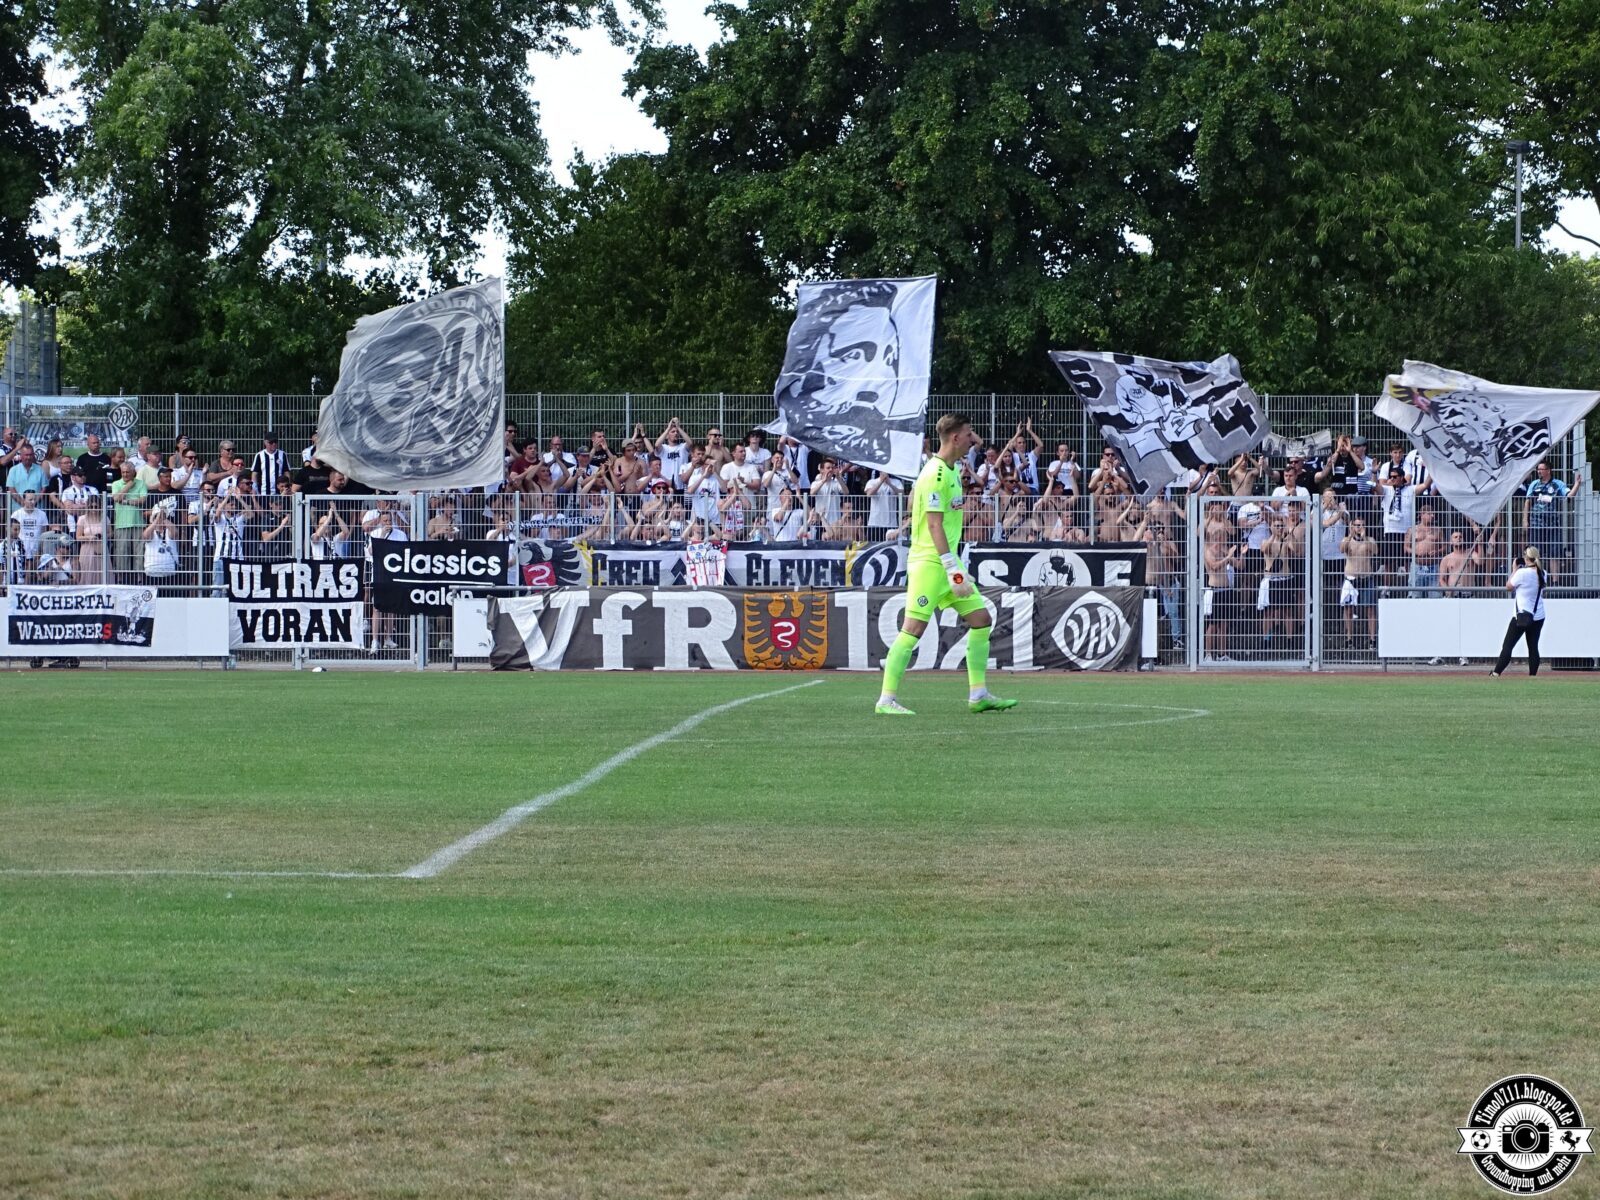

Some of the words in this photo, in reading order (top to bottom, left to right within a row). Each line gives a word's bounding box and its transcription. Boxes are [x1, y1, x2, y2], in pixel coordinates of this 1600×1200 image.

[383, 548, 502, 576] classics
[229, 562, 359, 599] ULTRAS
[16, 593, 115, 611] KOCHERTAL
[17, 621, 113, 640] WANDERERS
[237, 608, 353, 643] VORAN
[498, 590, 739, 671] VfR
[1066, 605, 1117, 660] VfR
